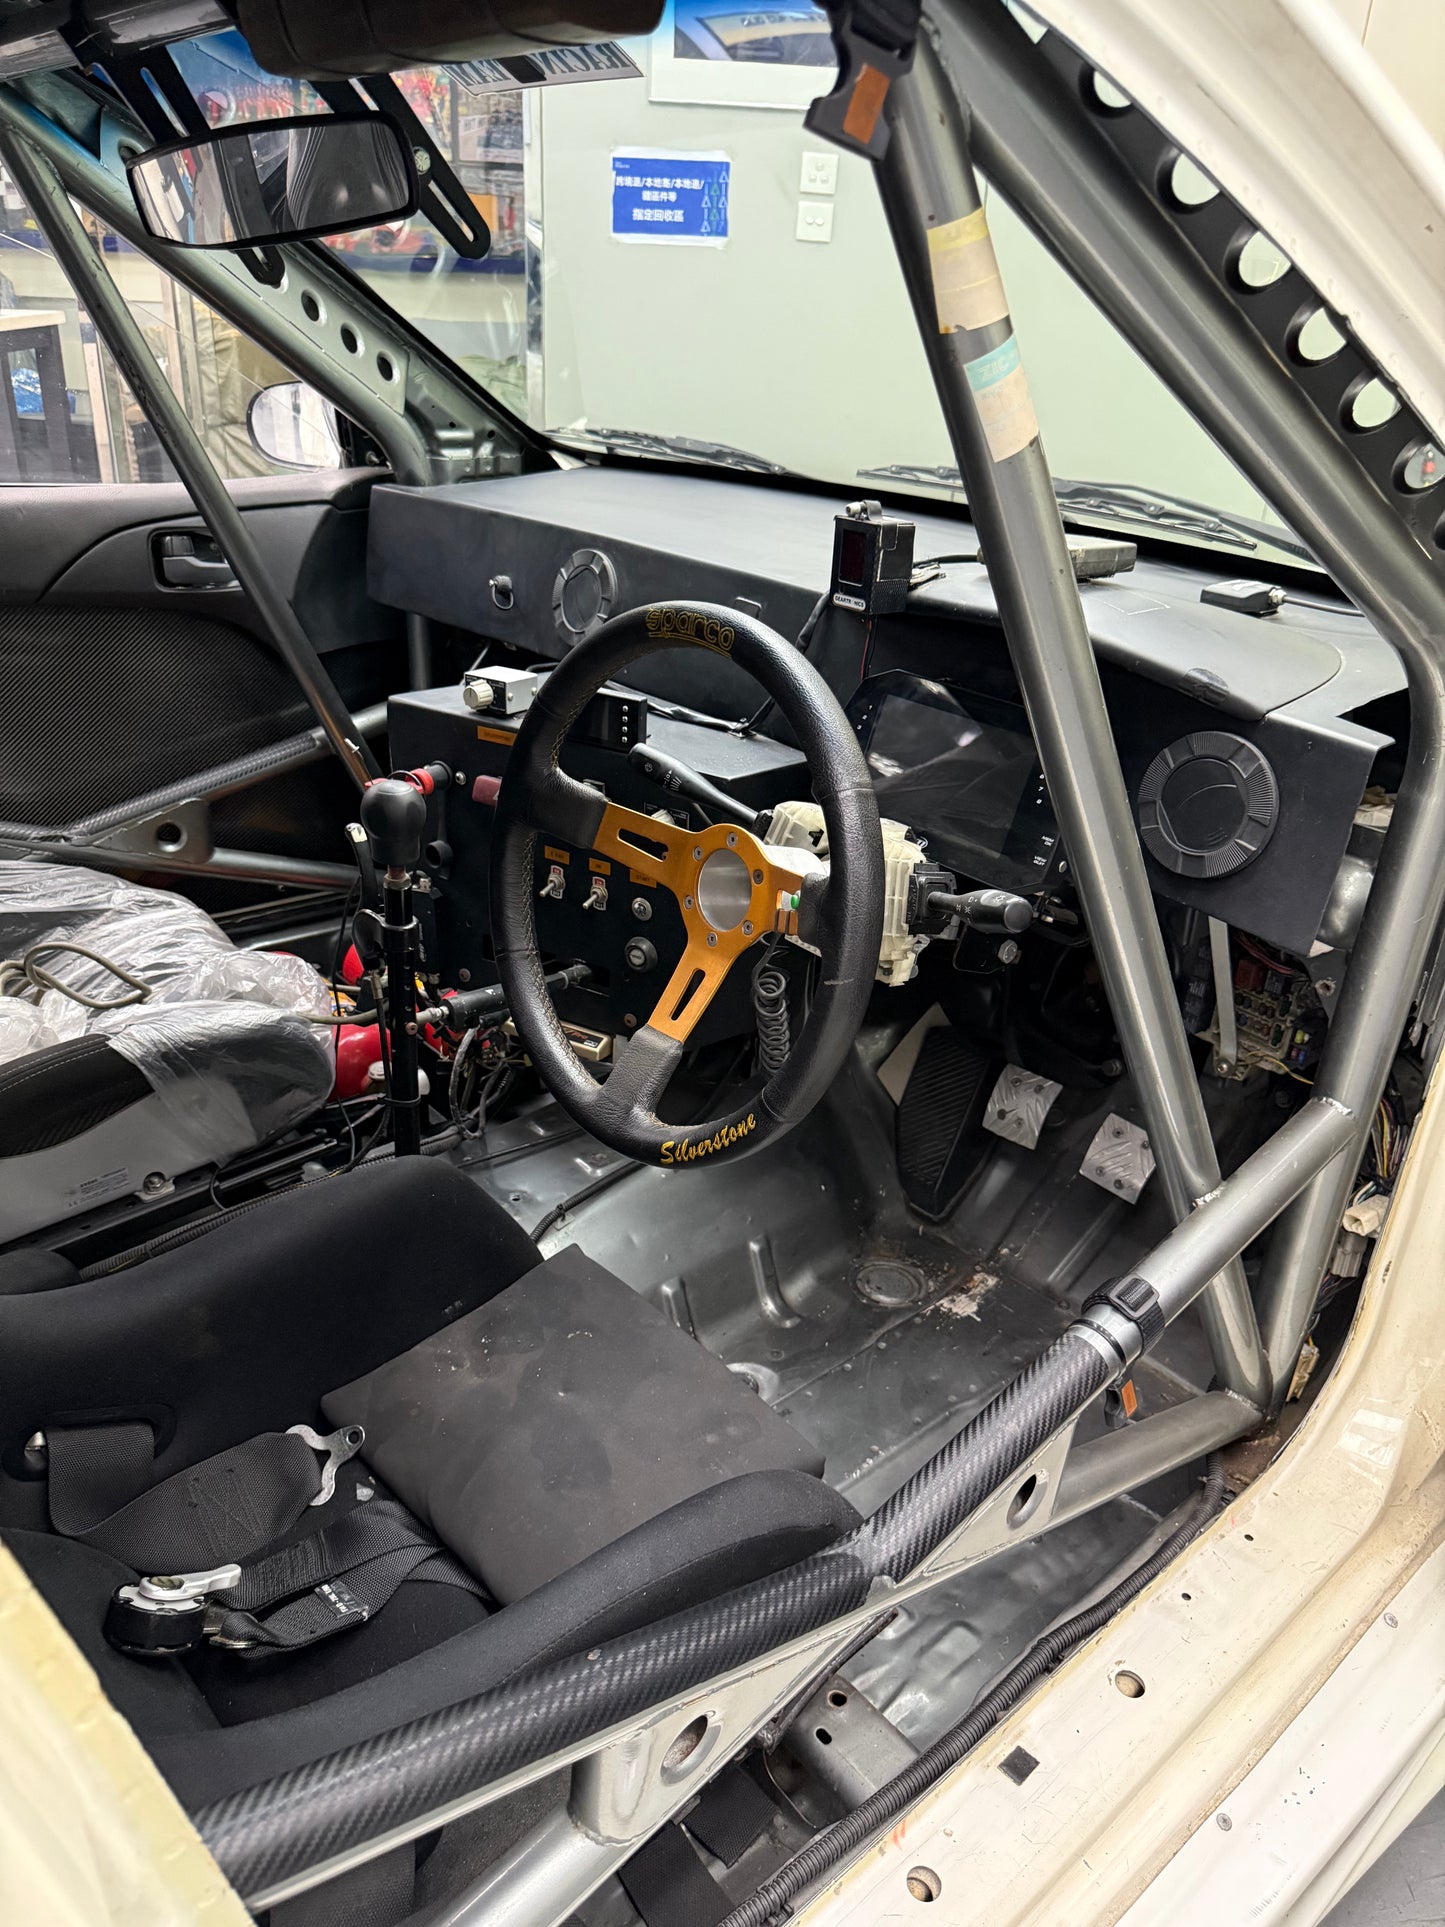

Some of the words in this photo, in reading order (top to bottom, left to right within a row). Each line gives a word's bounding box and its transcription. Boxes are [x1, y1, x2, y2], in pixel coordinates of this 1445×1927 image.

[632, 208, 685, 223] 指定回收區
[645, 608, 735, 651] sparco
[660, 1113, 756, 1165] Silverstone
